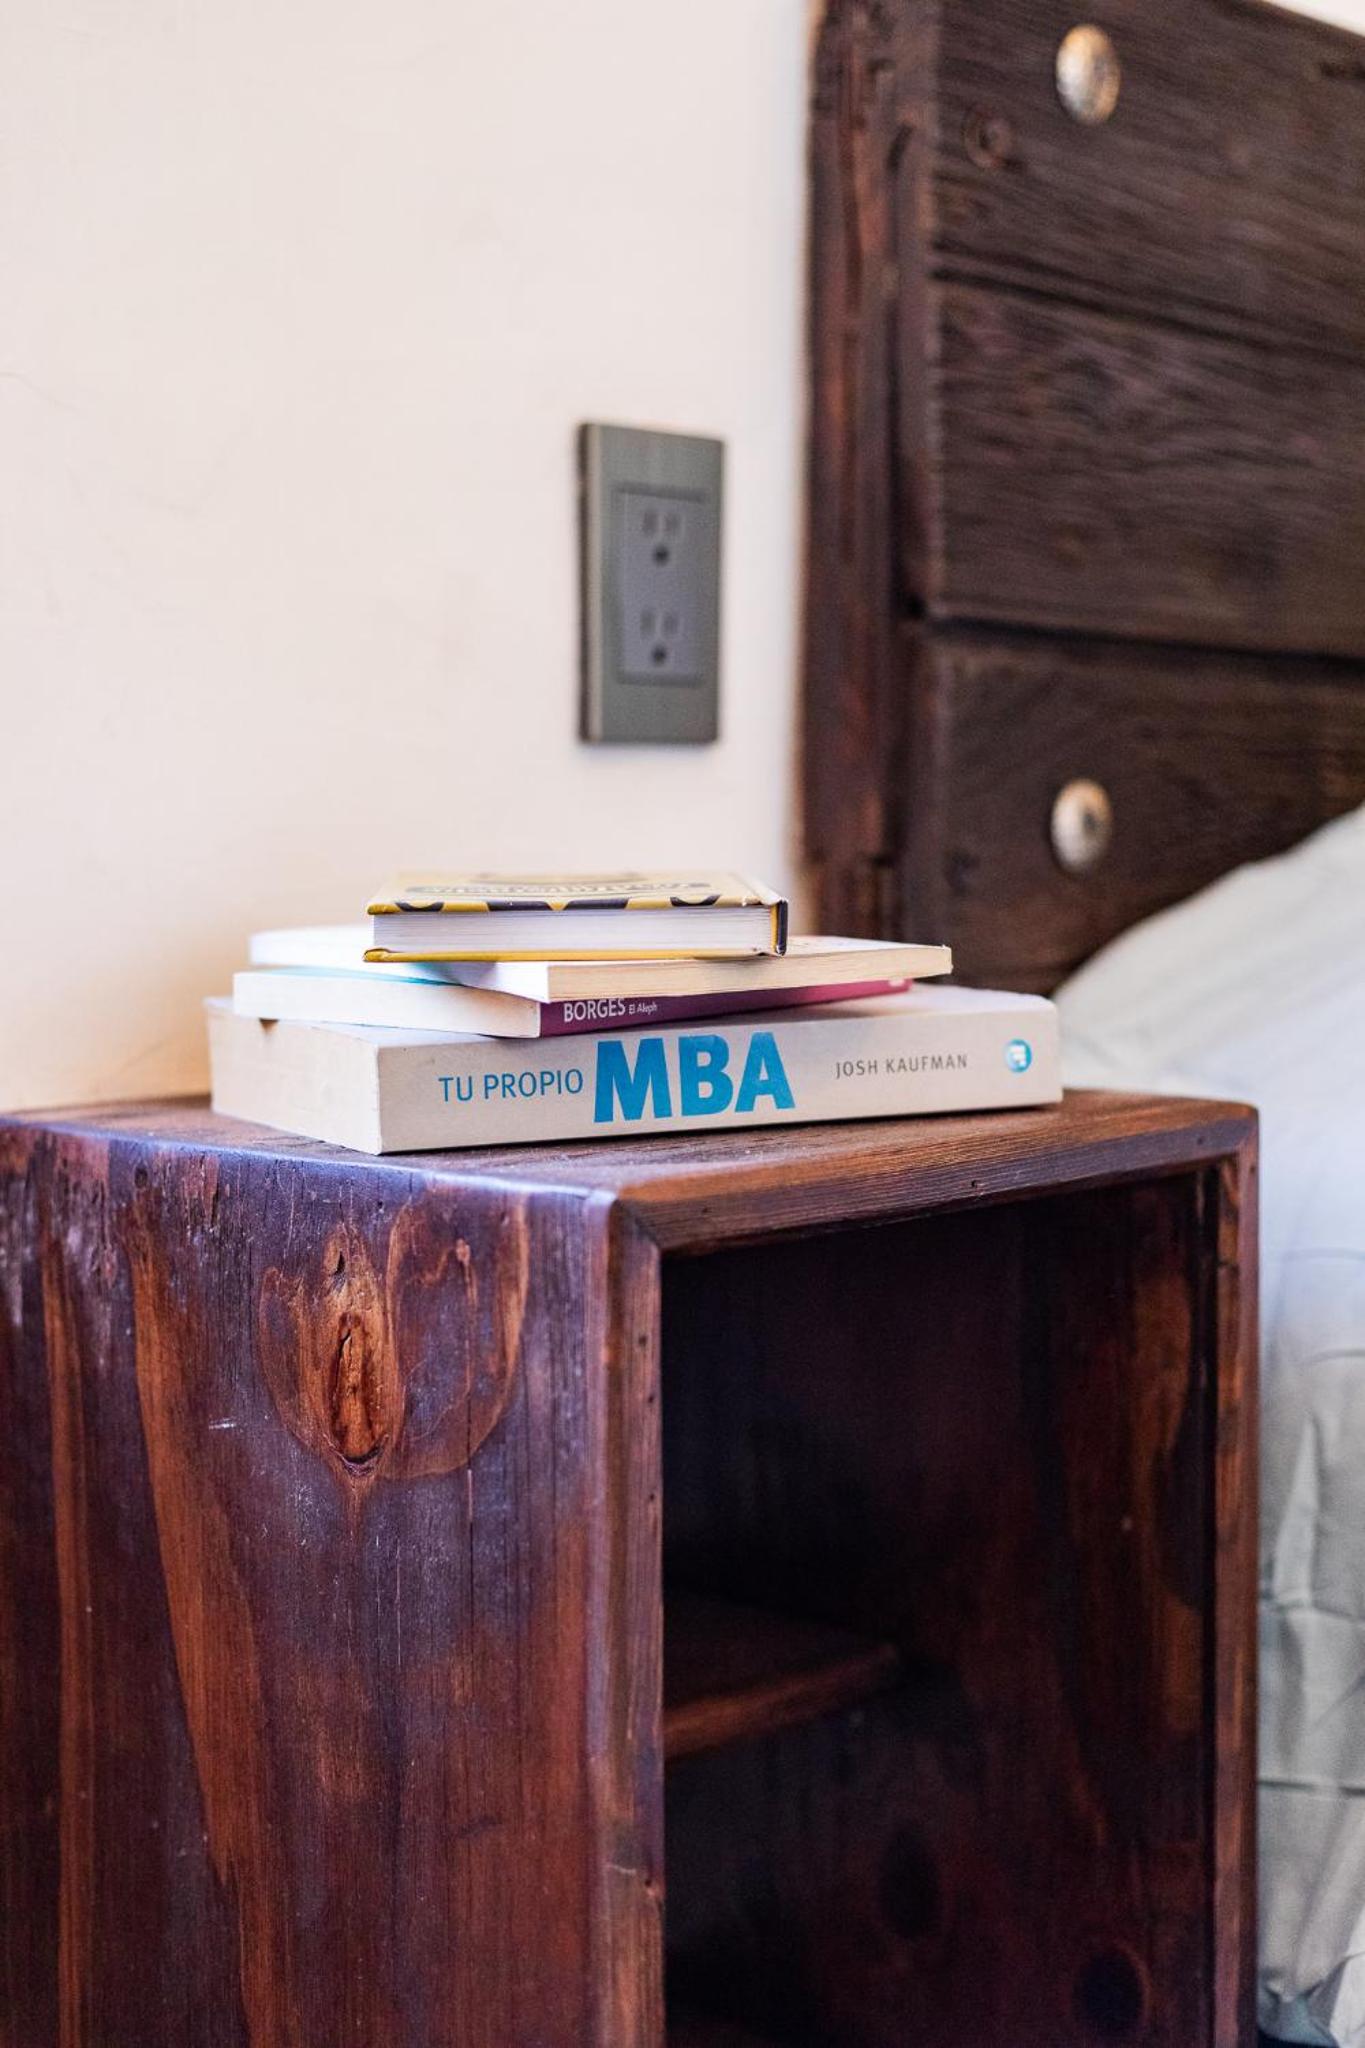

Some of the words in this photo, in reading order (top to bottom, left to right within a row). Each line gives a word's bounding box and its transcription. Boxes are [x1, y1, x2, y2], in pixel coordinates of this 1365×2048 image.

[563, 999, 626, 1022] BORGES
[628, 1003, 635, 1015] El
[637, 1002, 658, 1015] Aleph
[438, 1076, 473, 1102] TU
[484, 1068, 584, 1099] PROPIO
[594, 1032, 796, 1123] MBA
[836, 1059, 878, 1079] JOSH
[885, 1054, 967, 1073] KAUFMAN
